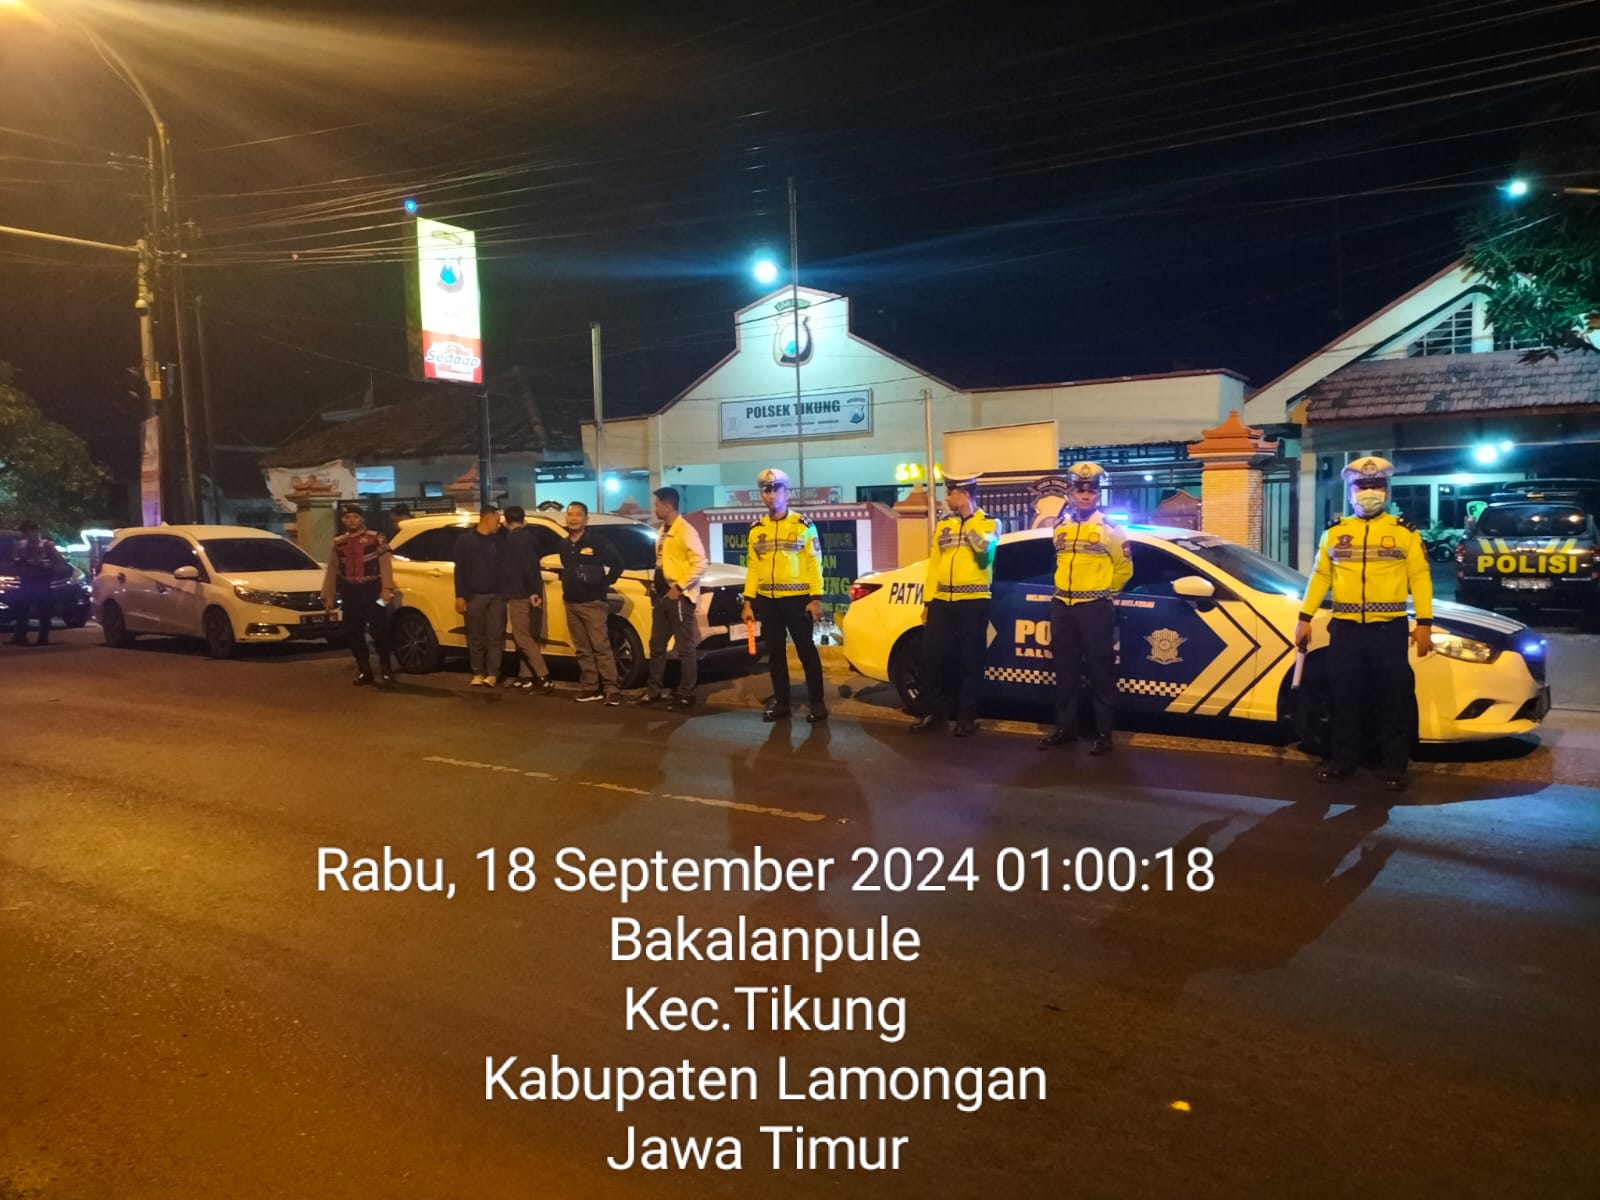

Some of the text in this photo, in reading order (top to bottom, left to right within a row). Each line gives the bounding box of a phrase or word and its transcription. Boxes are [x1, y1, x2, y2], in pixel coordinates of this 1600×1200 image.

[426, 349, 480, 368] Sedaap
[746, 404, 791, 420] POLSEK
[794, 399, 841, 416] TIKUNG
[1477, 554, 1578, 574] POLISI
